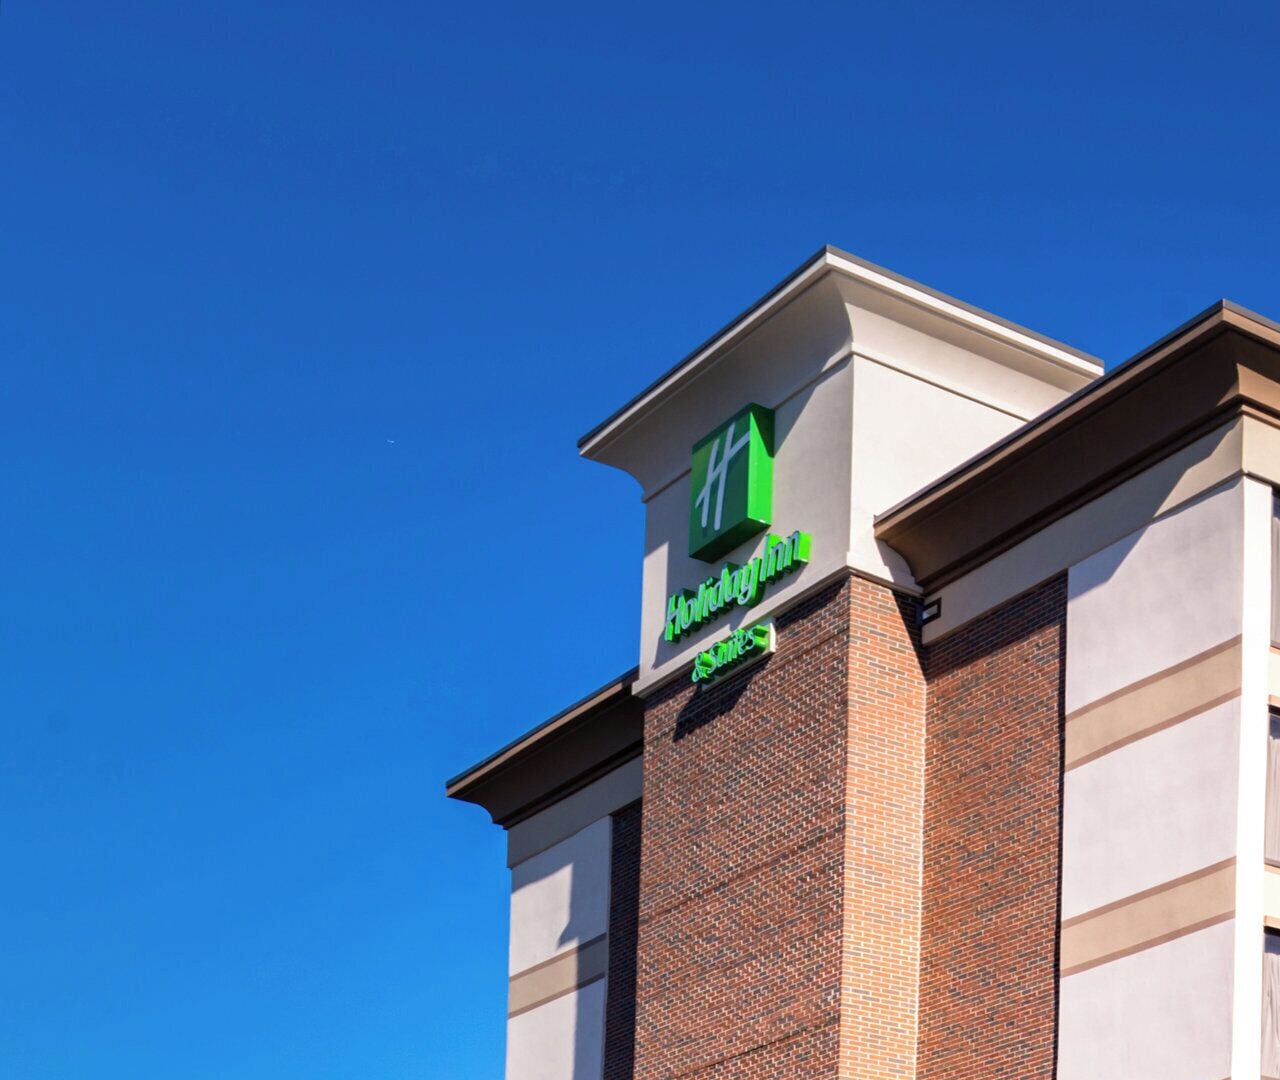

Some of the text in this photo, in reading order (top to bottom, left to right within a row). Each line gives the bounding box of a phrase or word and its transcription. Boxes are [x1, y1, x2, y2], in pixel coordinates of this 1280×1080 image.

[695, 421, 750, 532] H
[664, 530, 806, 642] Holiday Inn
[707, 625, 764, 673] Suites
